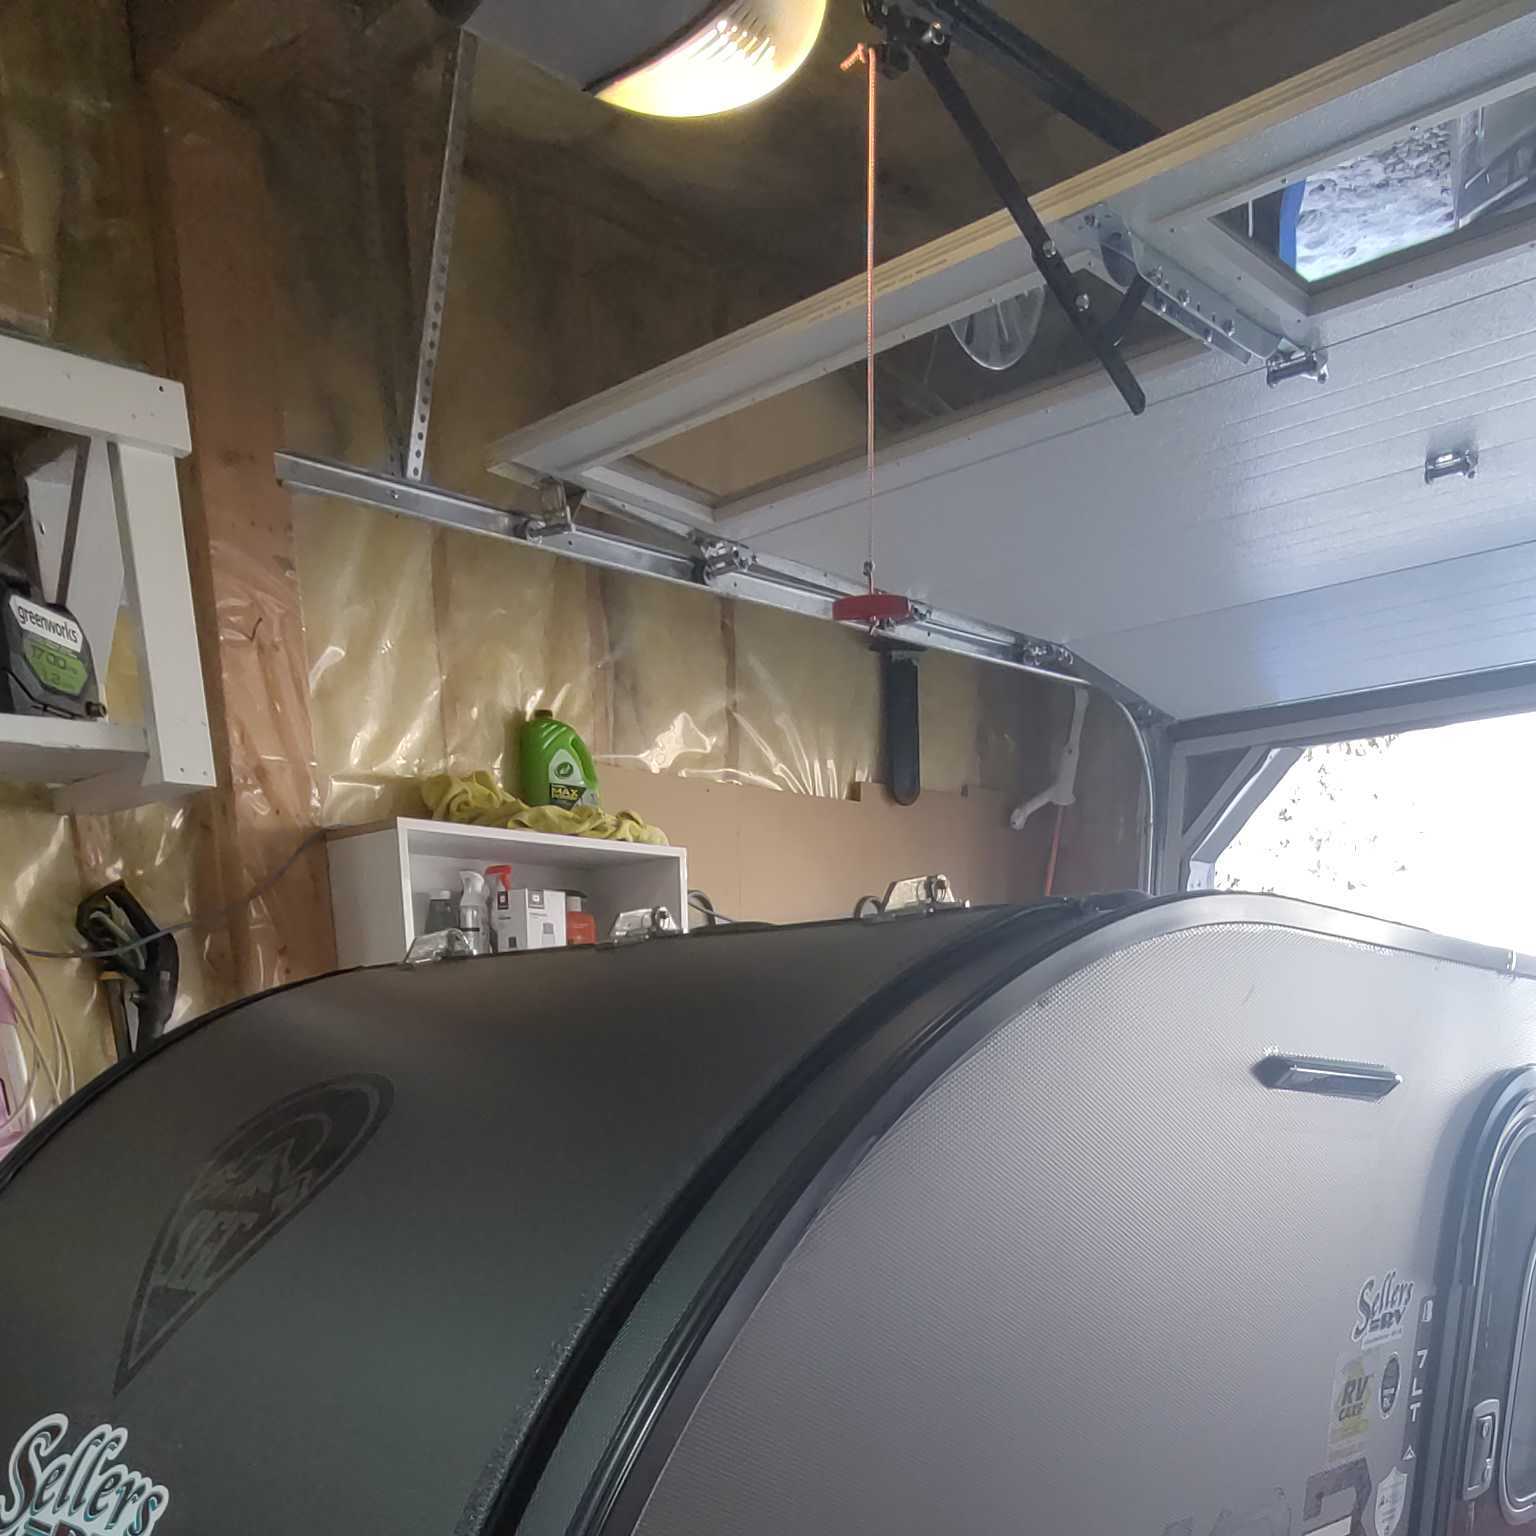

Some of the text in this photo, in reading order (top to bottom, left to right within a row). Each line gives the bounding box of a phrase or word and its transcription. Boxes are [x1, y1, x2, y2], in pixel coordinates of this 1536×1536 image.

[17, 606, 79, 643] greenworks
[30, 645, 66, 669] 1700
[551, 786, 579, 801] MAX
[1352, 1270, 1414, 1341] Sellers
[1341, 1376, 1370, 1407] RV
